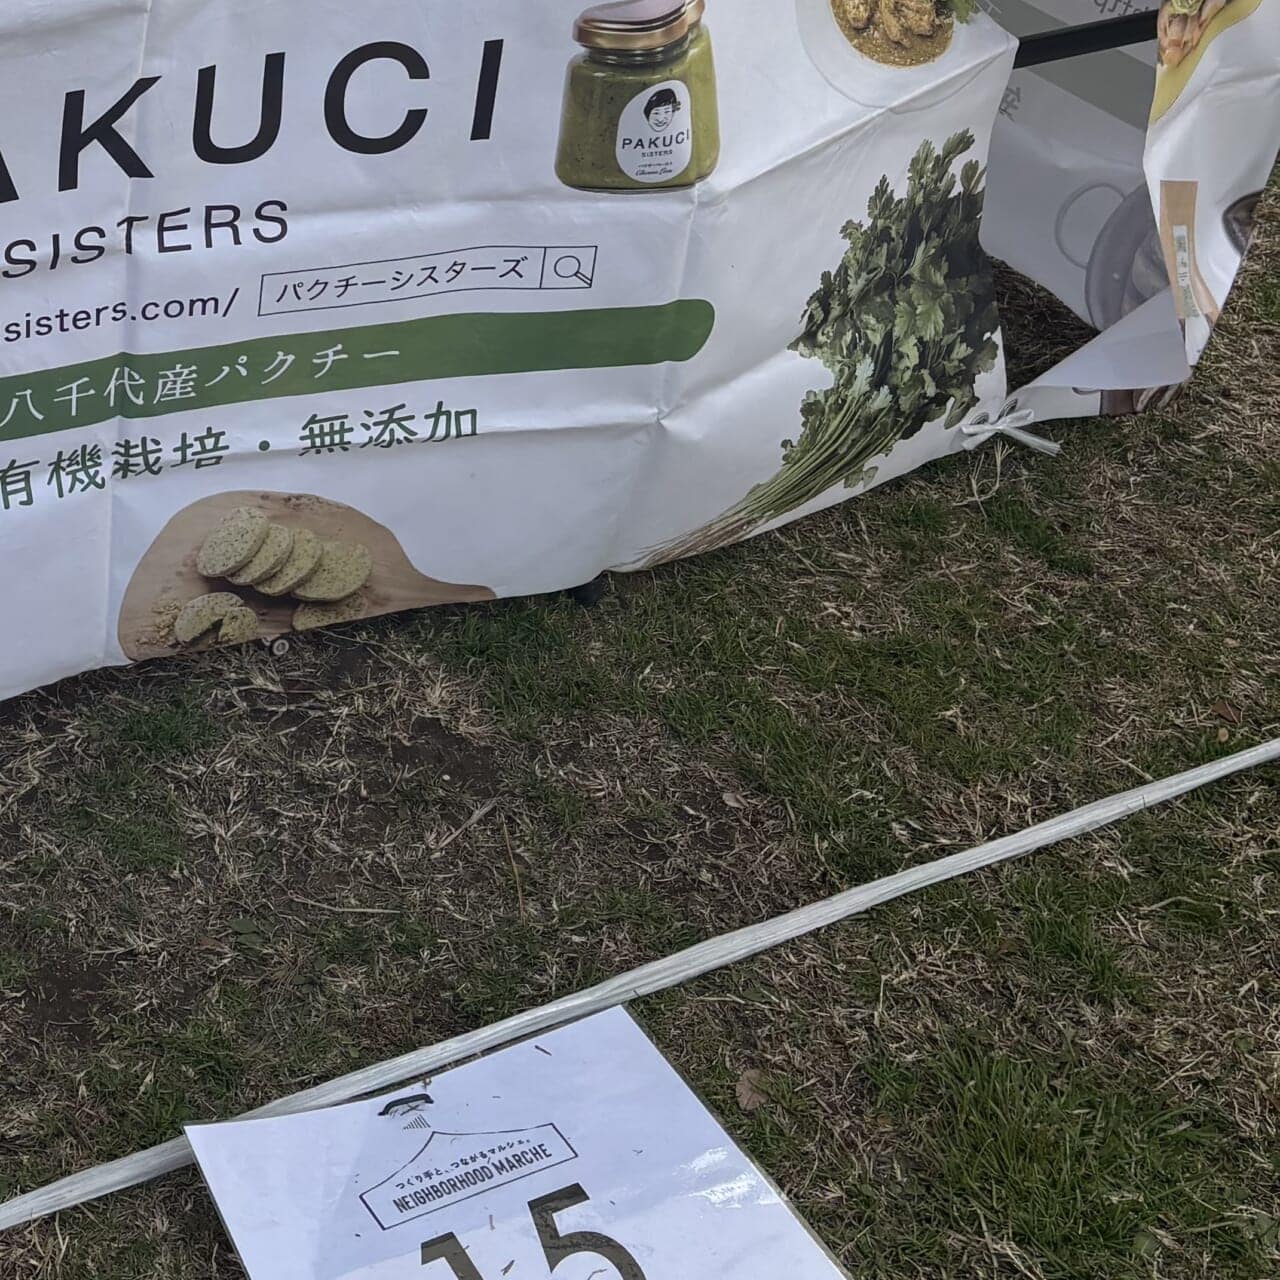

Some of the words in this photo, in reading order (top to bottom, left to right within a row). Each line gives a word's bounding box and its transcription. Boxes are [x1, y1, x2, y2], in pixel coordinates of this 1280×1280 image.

[622, 128, 690, 150] PAKUCI
[0, 200, 290, 279] SISTERS
[276, 255, 528, 303] パクチーシスターズ
[392, 1164, 495, 1214] NEIGHBORHOOD
[492, 1142, 553, 1176] MARCHE
